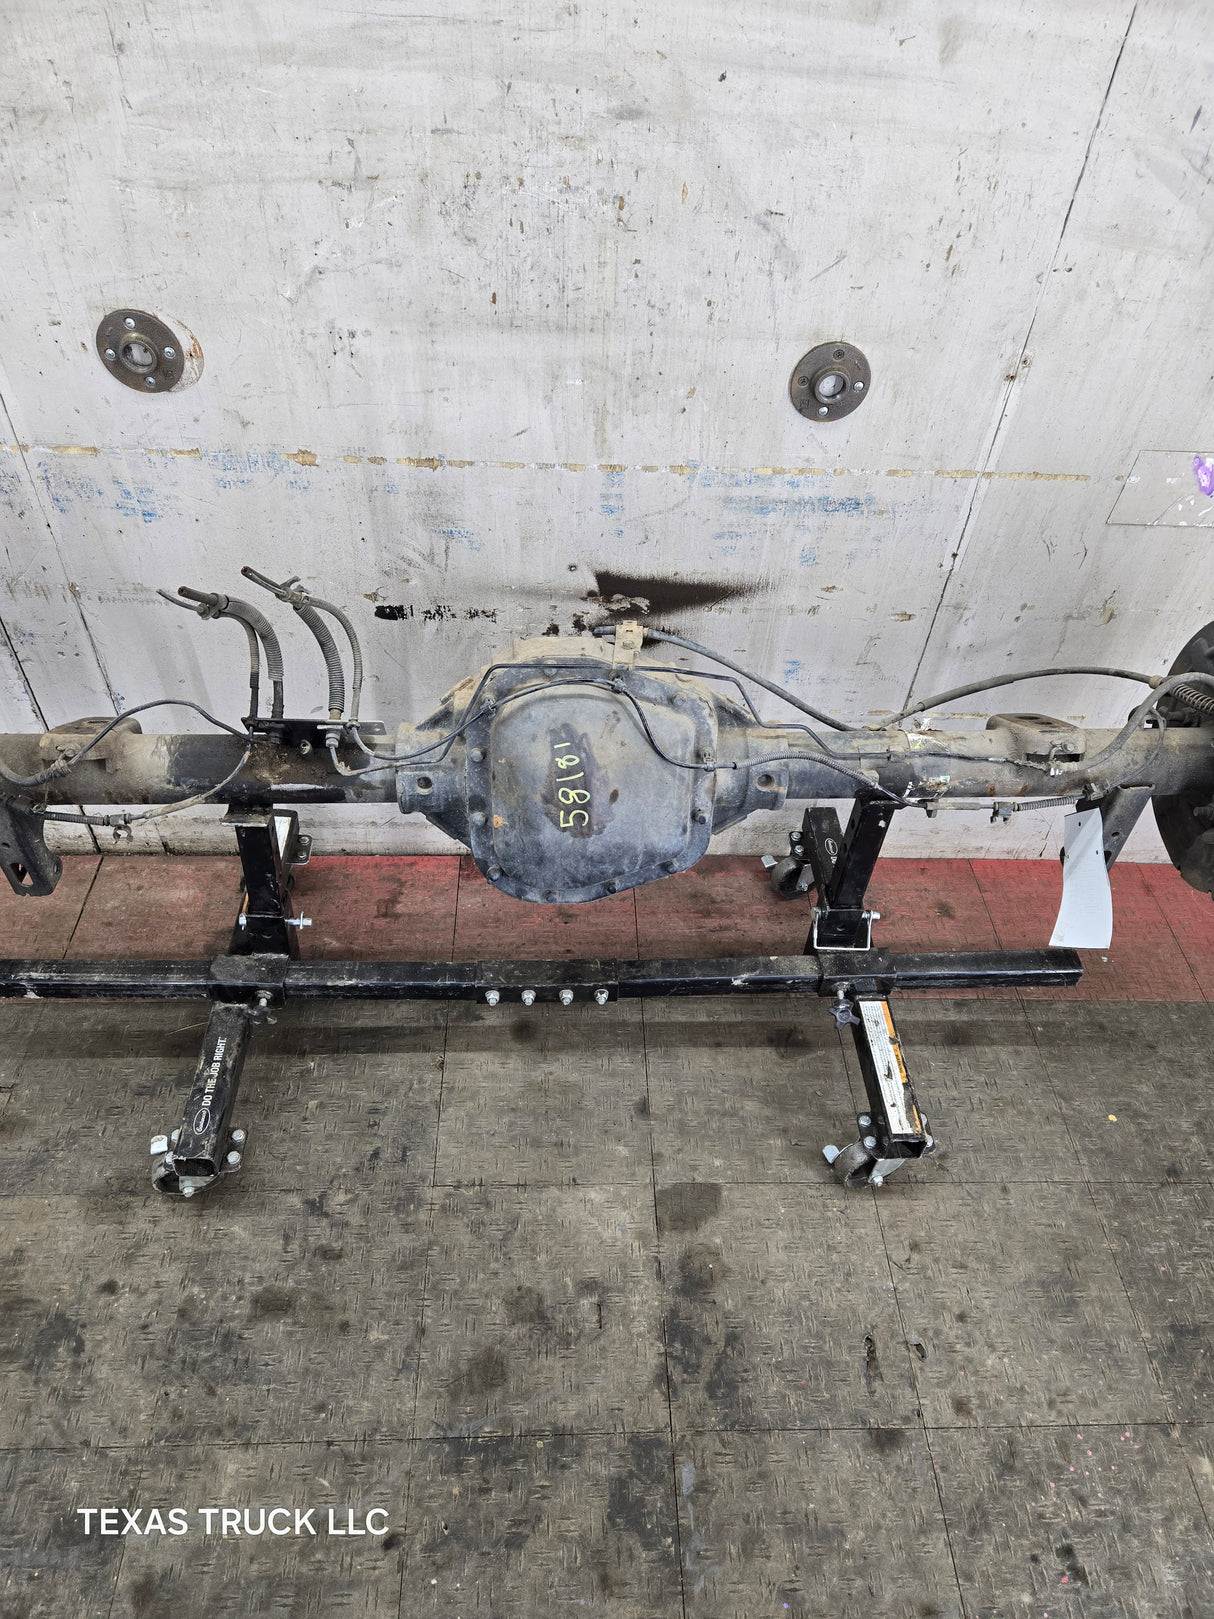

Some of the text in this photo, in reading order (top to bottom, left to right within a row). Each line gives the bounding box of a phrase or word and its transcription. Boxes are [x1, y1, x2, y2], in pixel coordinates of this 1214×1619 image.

[553, 742, 591, 828] 58181
[209, 1062, 221, 1078] JOB
[205, 1078, 217, 1093] THE
[202, 1094, 213, 1106] DO
